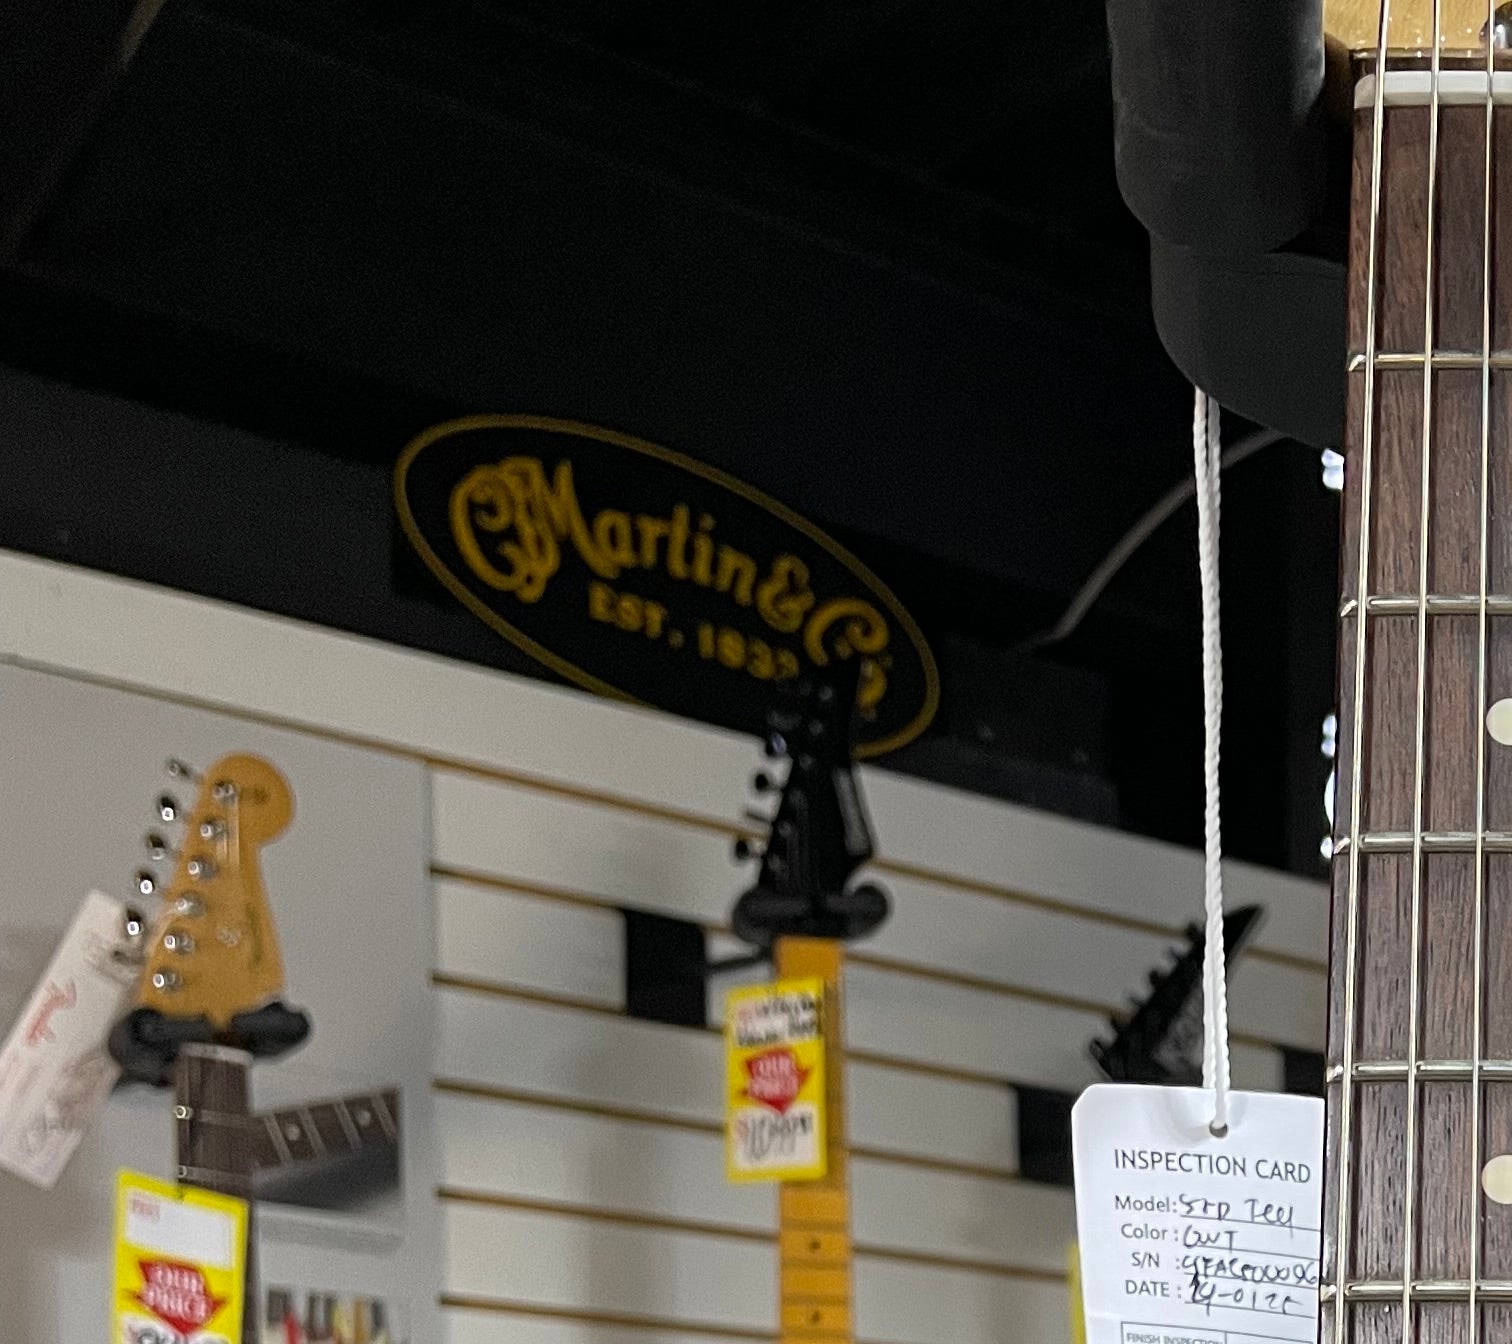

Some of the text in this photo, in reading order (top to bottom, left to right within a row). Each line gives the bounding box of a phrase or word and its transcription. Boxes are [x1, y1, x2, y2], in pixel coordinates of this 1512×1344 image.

[1114, 1149, 1311, 1183] INSPECTION CARD
[1115, 1196, 1177, 1213] Model:
[1127, 1333, 1160, 1344] FINISH
